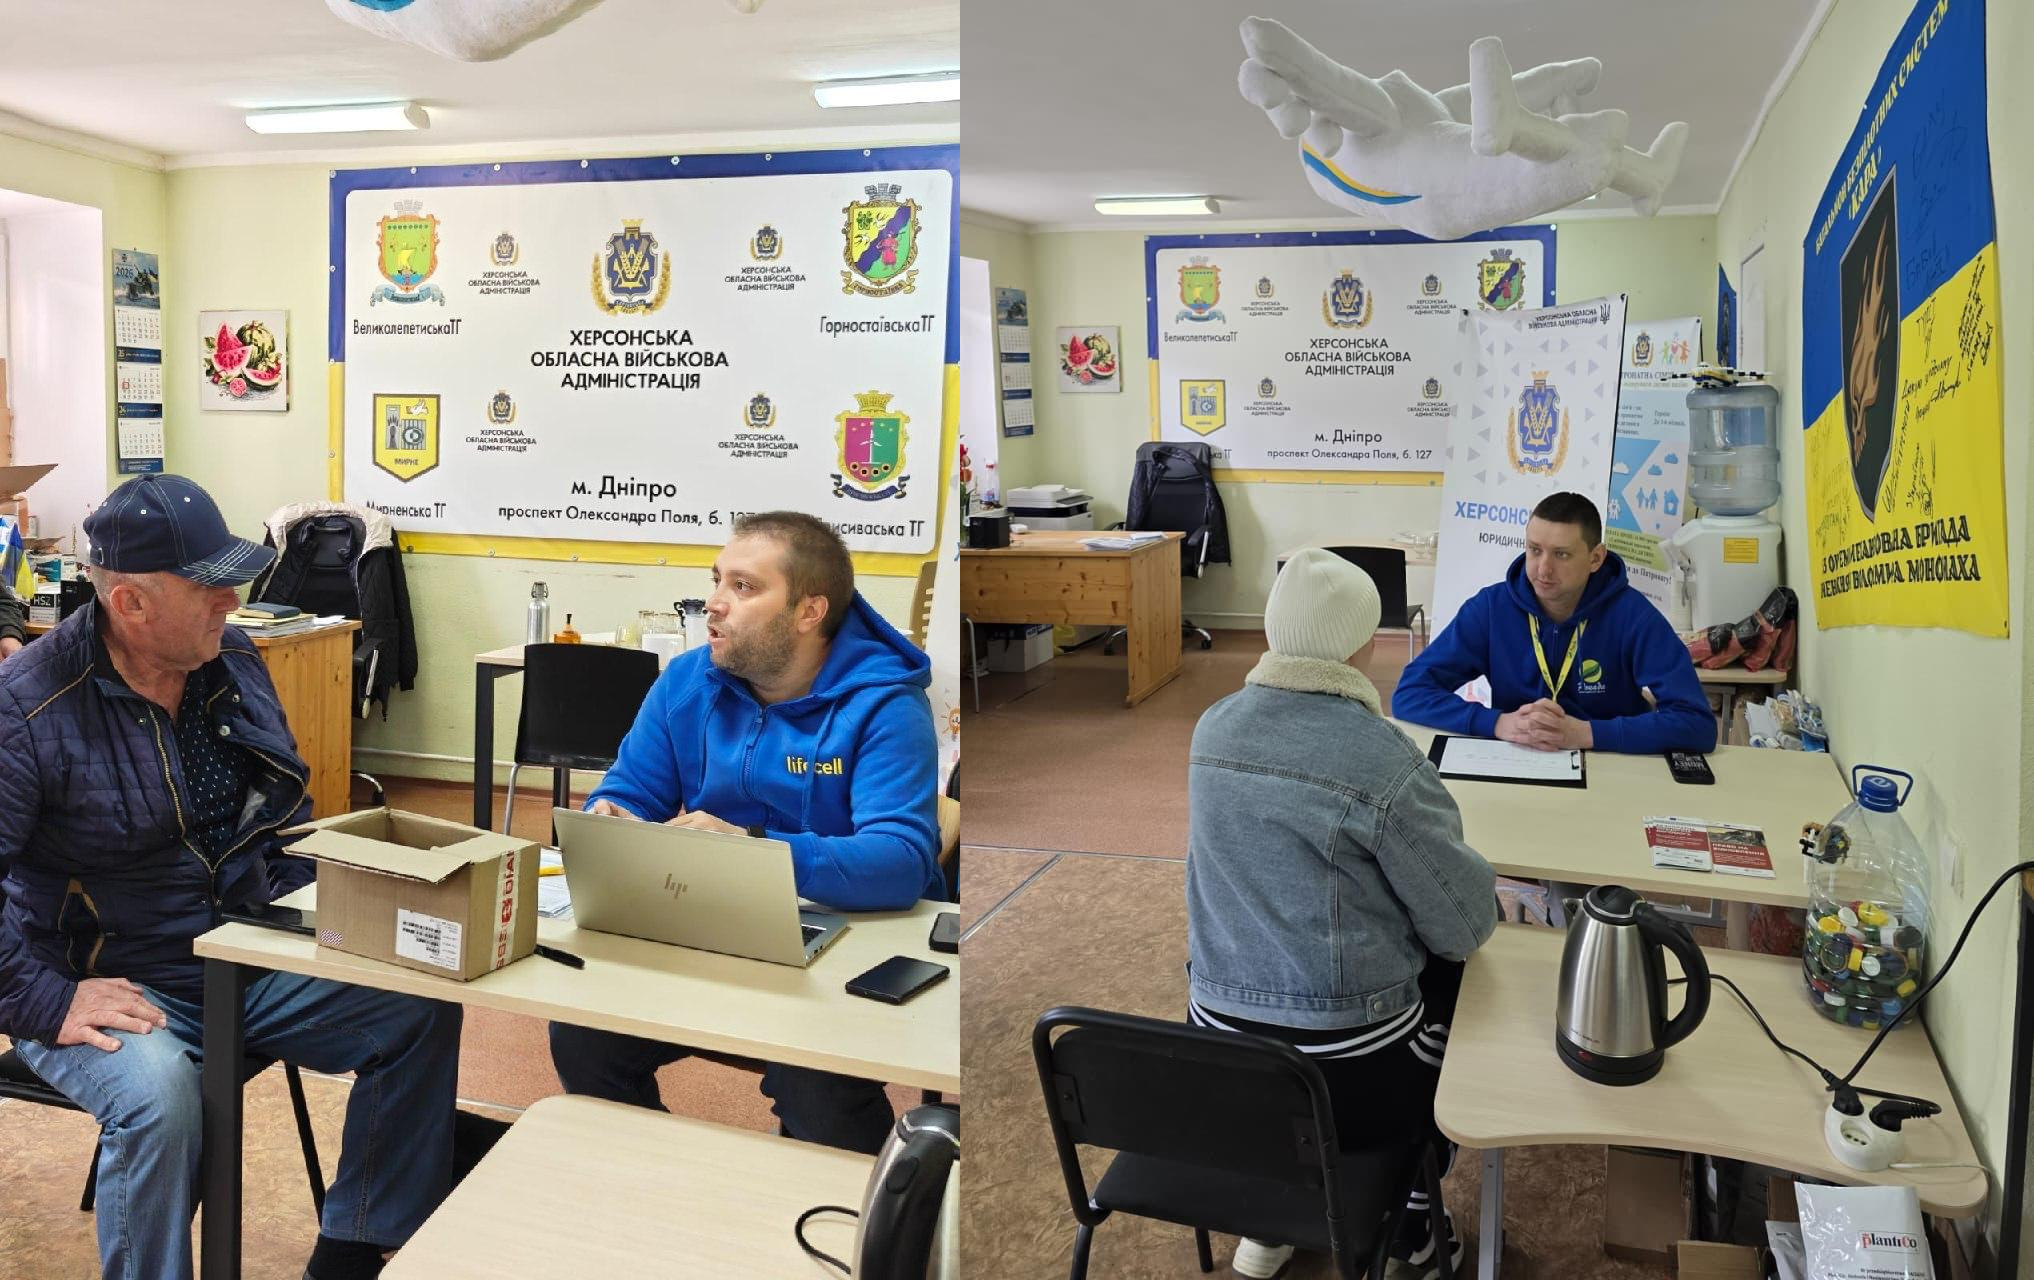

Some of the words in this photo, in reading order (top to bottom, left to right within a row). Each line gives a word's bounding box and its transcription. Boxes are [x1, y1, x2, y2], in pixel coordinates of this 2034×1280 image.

[569, 329, 693, 347] ХЕРСОНСЬКА
[1310, 338, 1389, 349] ХЕРСОНСЬКА
[530, 351, 619, 368] ОБЛАСНА
[624, 348, 729, 367] ВІЙСЬКОВА
[1284, 352, 1343, 362] ОБЛАСНА
[1345, 350, 1412, 362] ВІЙСЬКОВА
[1305, 365, 1395, 377] АДМІНІСТРАЦІЯ
[560, 373, 701, 391] АДМІНІСТРАЦІЯ
[1314, 433, 1328, 442] м.
[1332, 429, 1382, 445] Дніпро
[1267, 450, 1309, 459] проспект
[1311, 449, 1370, 462] Олександра
[1373, 450, 1399, 460] Поля,
[1416, 450, 1432, 459] 127
[571, 480, 592, 496] м.
[598, 475, 677, 502] Дніпро
[433, 502, 447, 519] ТГ
[498, 506, 562, 521] проспект
[565, 506, 656, 526] Олександра
[661, 509, 702, 527] Поля,
[708, 510, 723, 525] б.
[828, 520, 905, 536] исиваська
[909, 520, 925, 537] ТГ
[1479, 532, 1526, 549] ЮРИДИЧН
